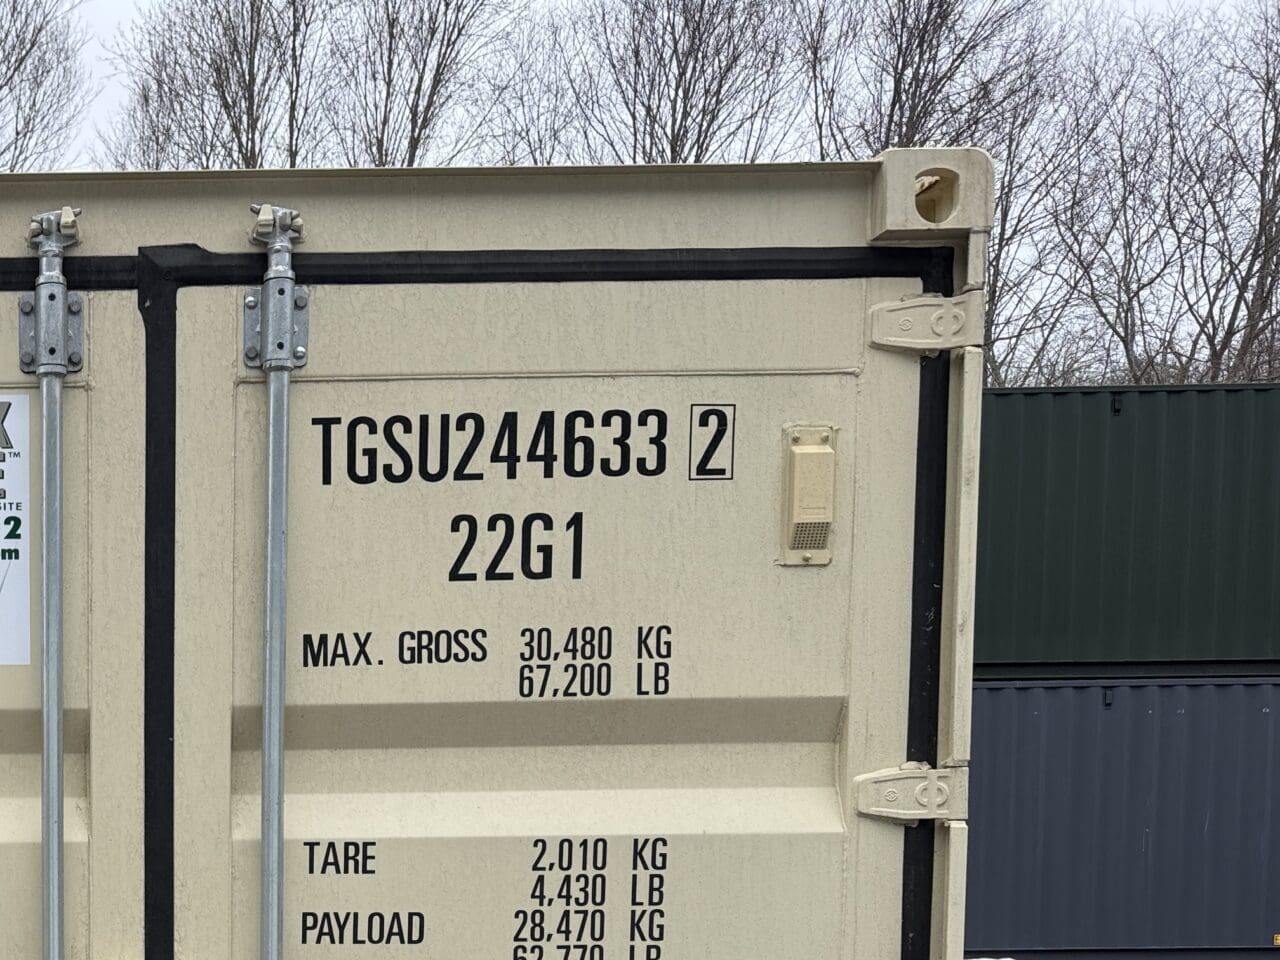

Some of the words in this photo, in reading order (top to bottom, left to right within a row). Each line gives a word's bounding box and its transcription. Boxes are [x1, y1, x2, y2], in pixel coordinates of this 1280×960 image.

[312, 409, 669, 487] TGSU244633
[696, 409, 728, 477] 2
[449, 512, 585, 583] 22G1
[303, 632, 385, 669] MAX.
[399, 629, 489, 666] GROSS
[520, 627, 613, 663] 30,480
[638, 625, 673, 661] KG
[519, 663, 613, 699] 67,200
[637, 662, 671, 697] LB
[304, 842, 378, 876] TARE
[532, 838, 609, 873] 2,010
[633, 838, 669, 872] KG
[531, 874, 607, 908] 4,430
[632, 874, 666, 908] LB
[302, 912, 426, 946] PAYLOAD
[514, 909, 606, 944] 28,470
[630, 909, 666, 943] KG
